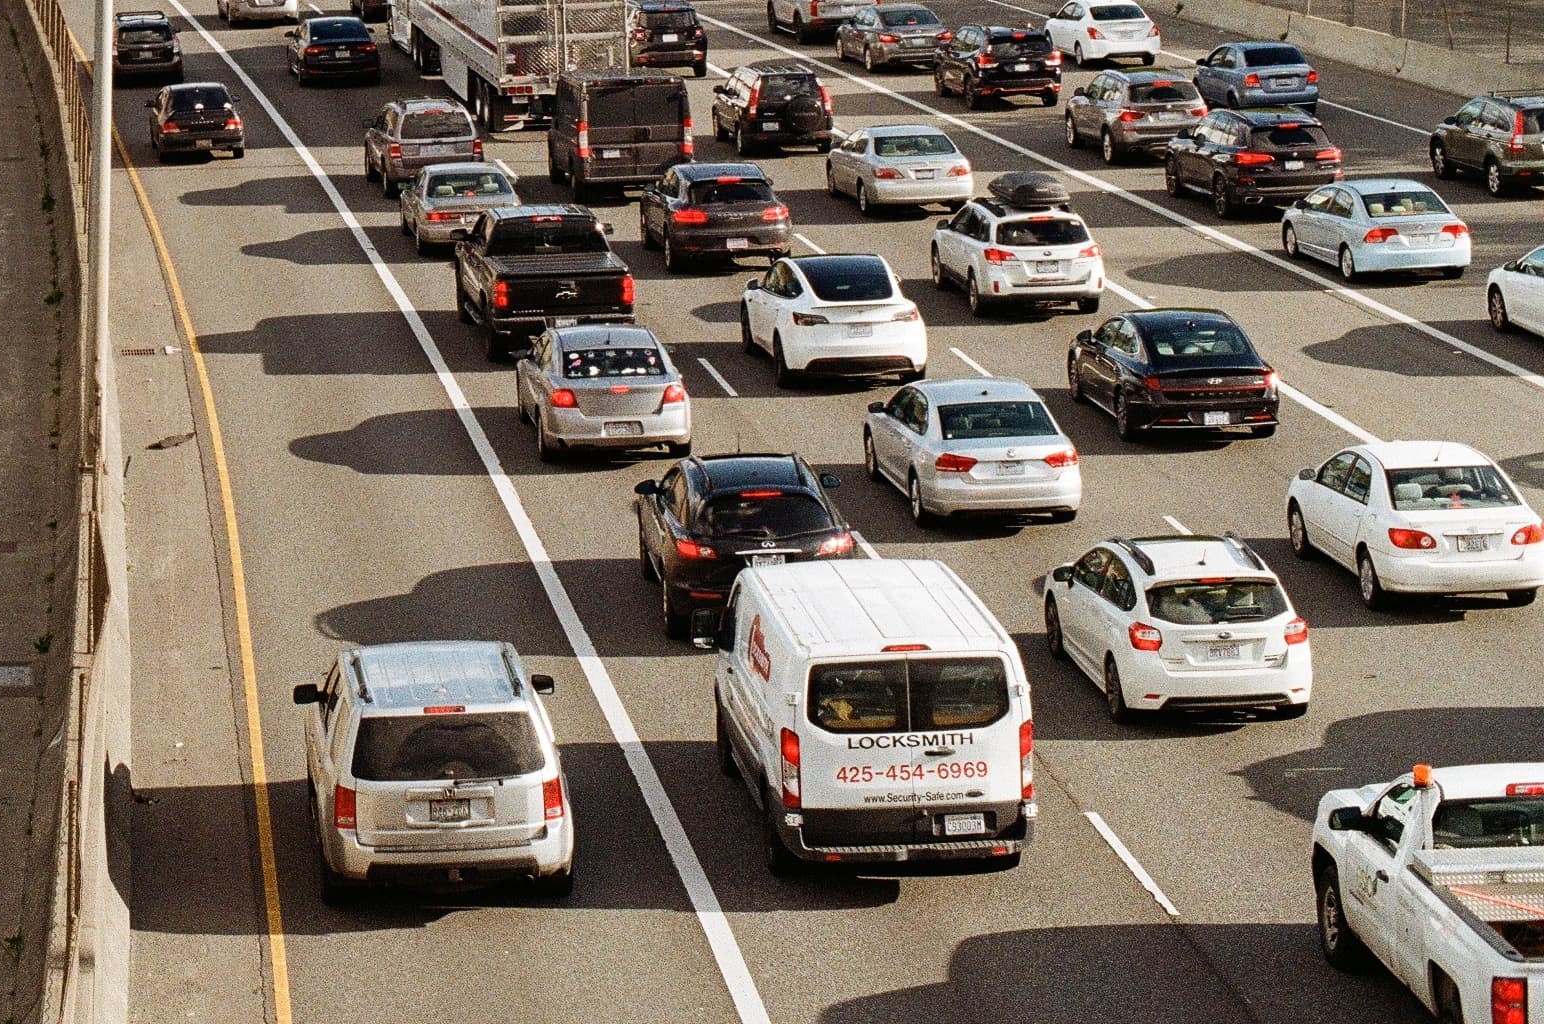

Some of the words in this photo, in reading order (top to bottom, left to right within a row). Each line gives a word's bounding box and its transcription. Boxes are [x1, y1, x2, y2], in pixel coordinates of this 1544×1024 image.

[847, 732, 974, 750] LOCKSMITH
[836, 761, 988, 783] 425-454-6969
[863, 791, 964, 804] www.Security-Safe.com
